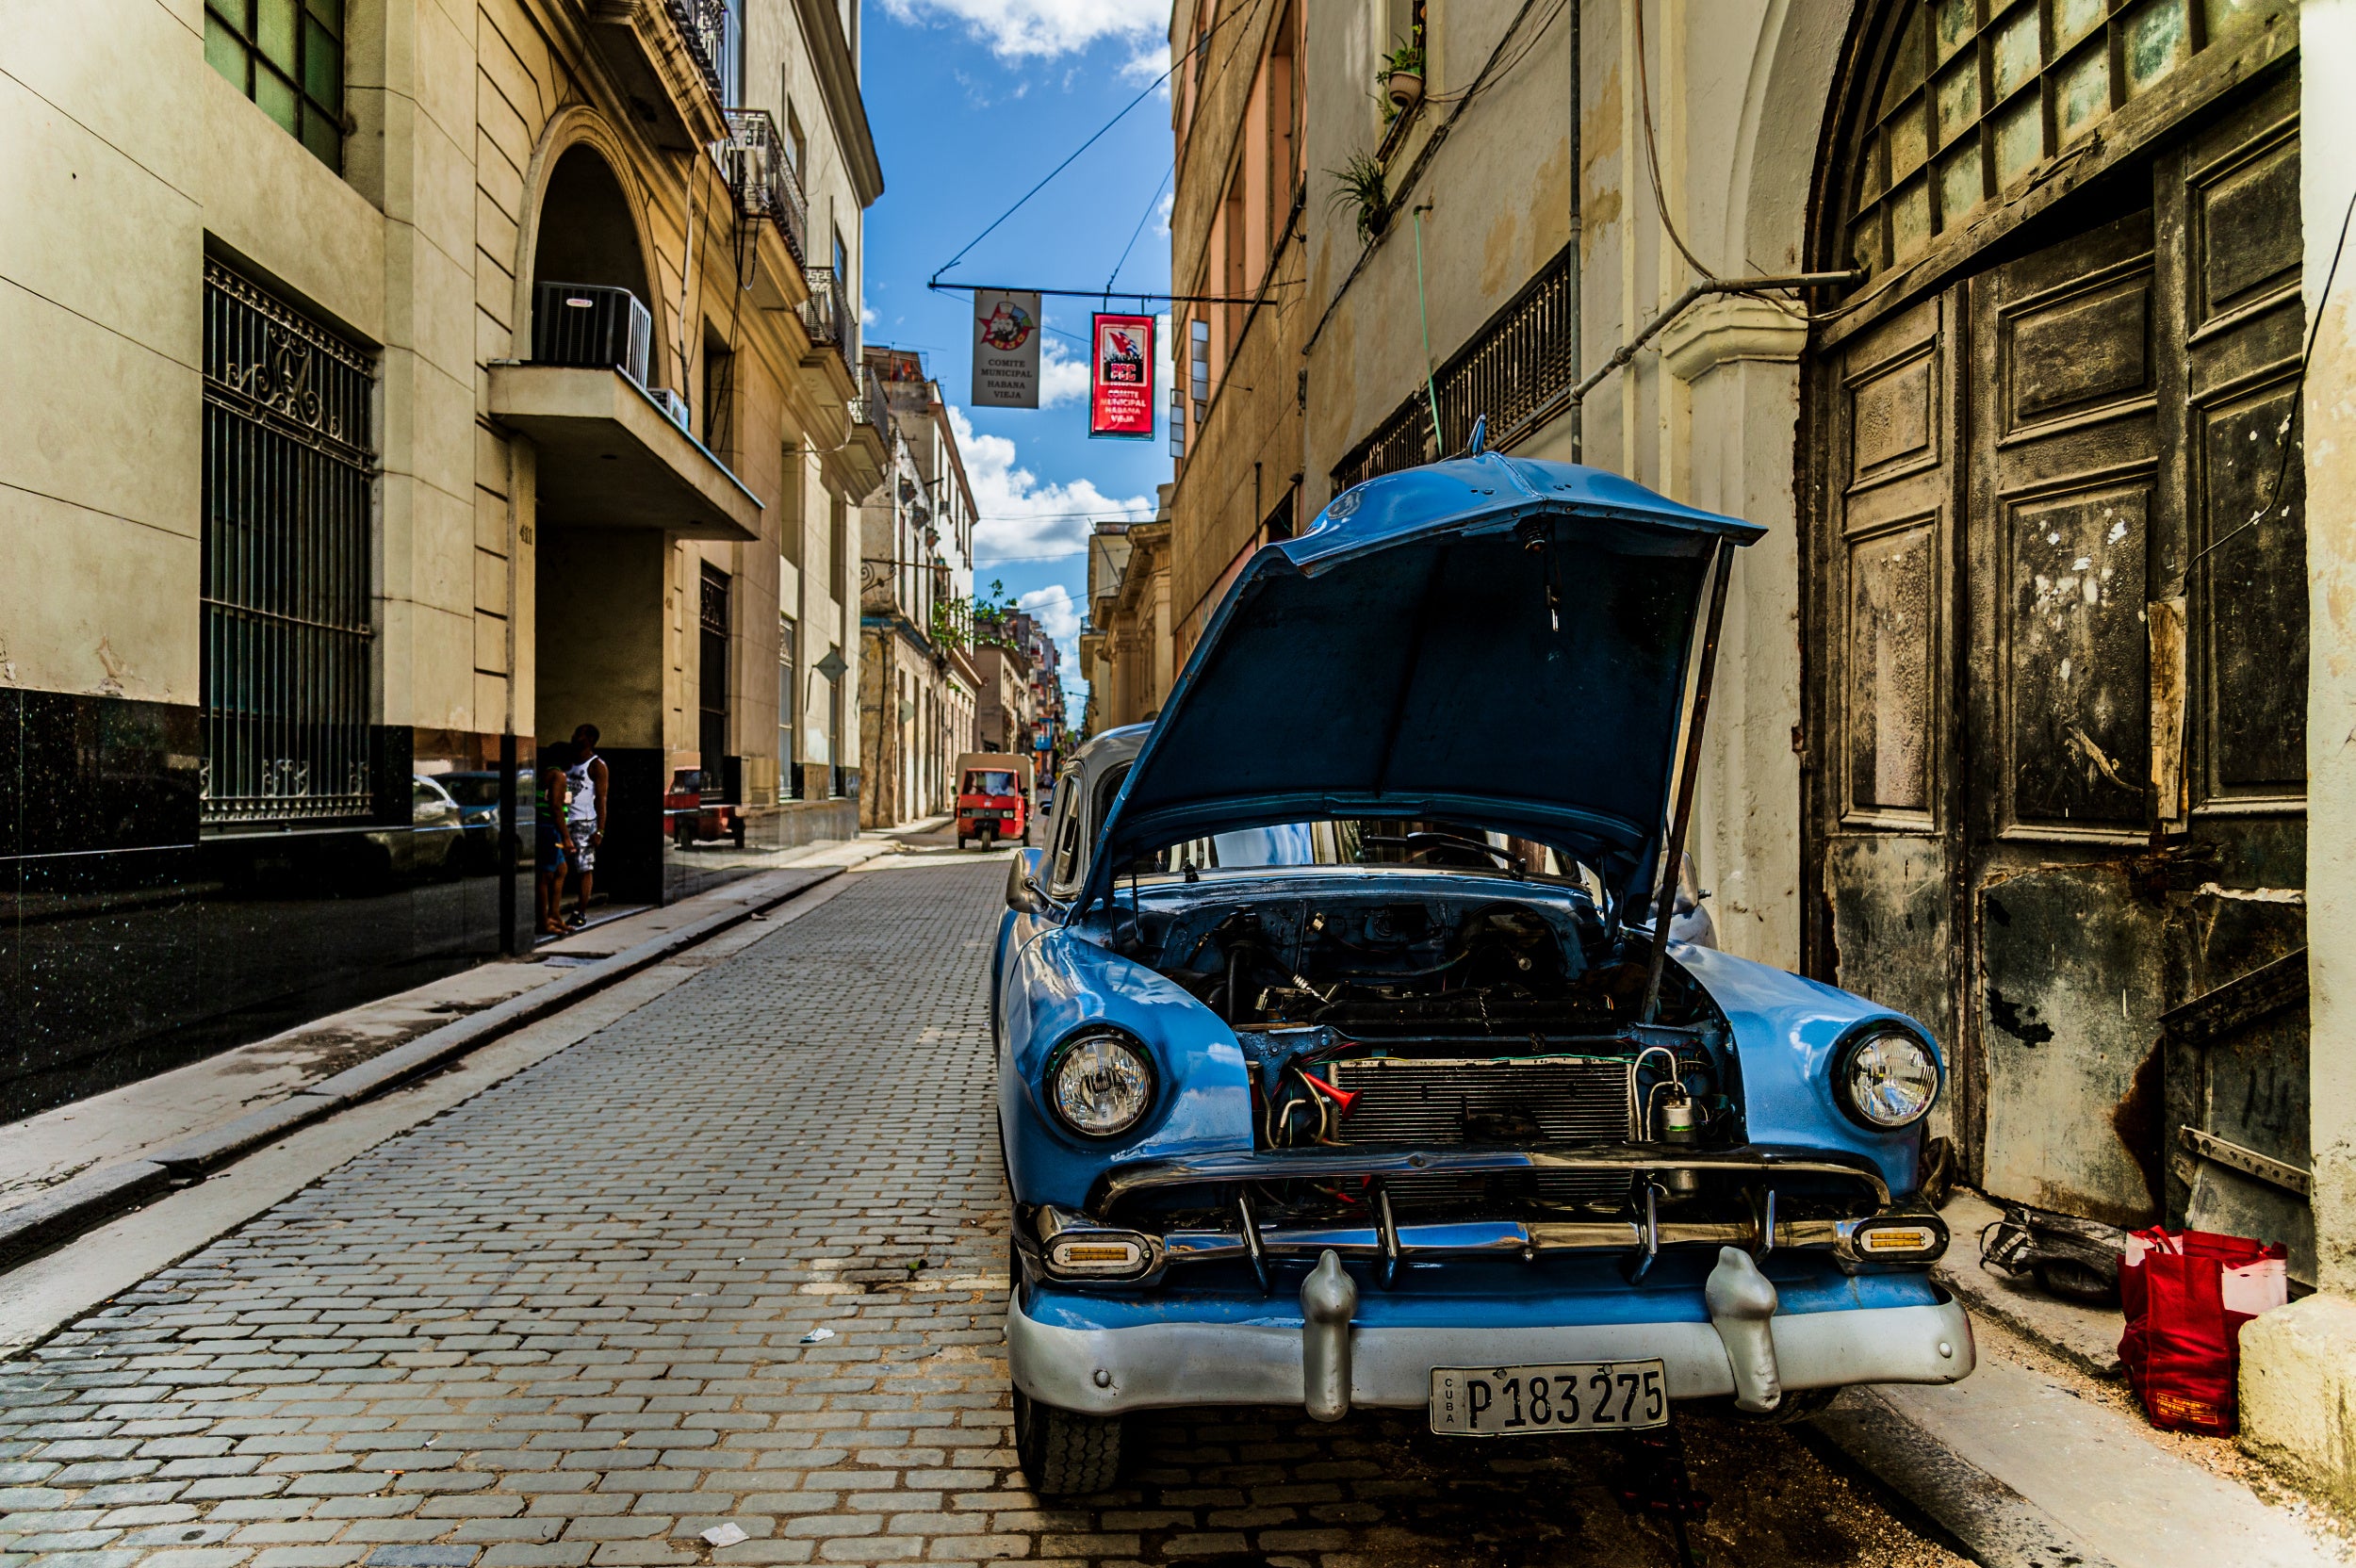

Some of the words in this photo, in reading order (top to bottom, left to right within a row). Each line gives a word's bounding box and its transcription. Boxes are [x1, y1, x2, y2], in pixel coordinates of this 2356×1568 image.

[988, 359, 1025, 368] COMITE
[981, 368, 1032, 378] MUNICIPAL
[988, 380, 1025, 389] HABANA
[1107, 389, 1139, 399] COMITE
[1100, 398, 1146, 407] MUNICIPAL
[1104, 406, 1141, 415] HABANA
[1110, 415, 1135, 423] VIEJA
[1445, 1378, 1454, 1424] CUBA
